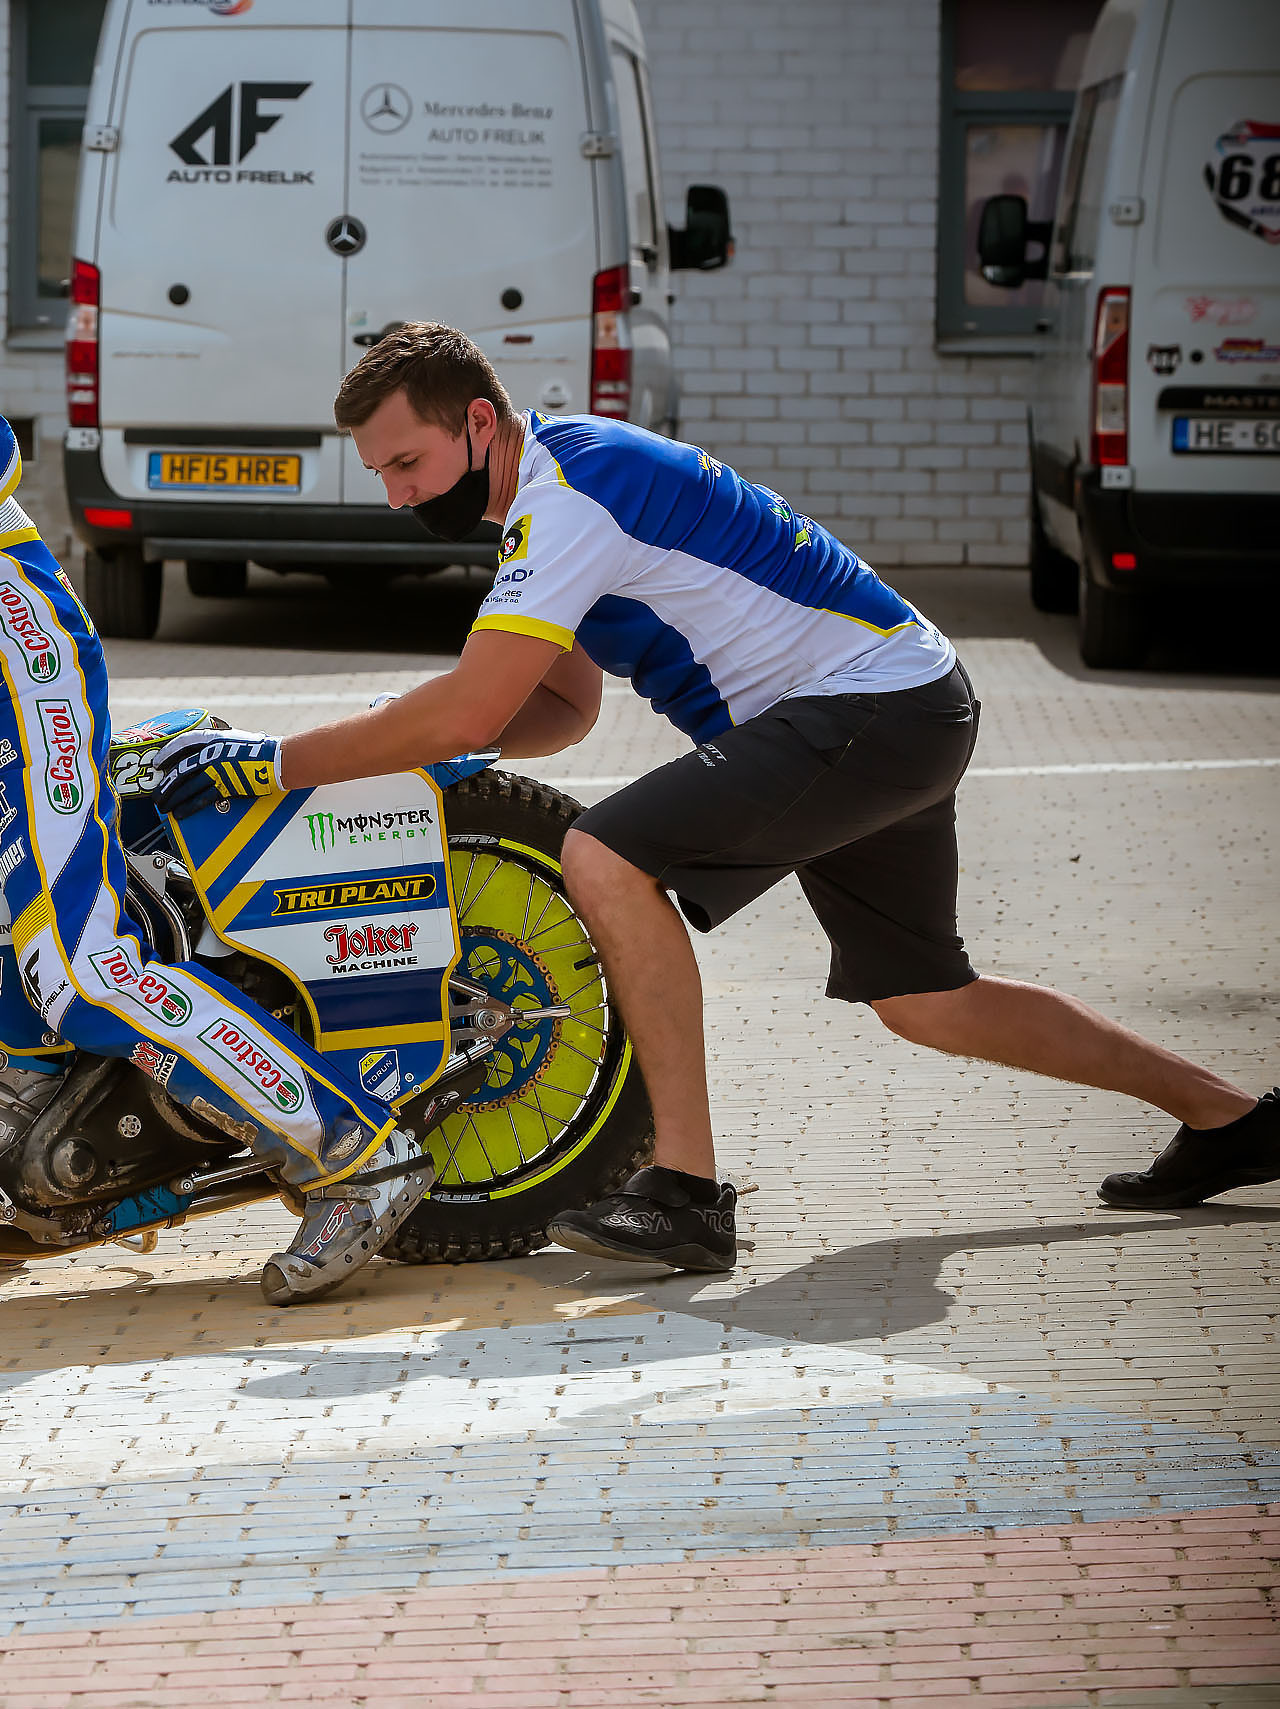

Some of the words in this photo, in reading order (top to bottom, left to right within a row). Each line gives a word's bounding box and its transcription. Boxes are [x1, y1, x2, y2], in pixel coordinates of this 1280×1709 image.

[428, 128, 479, 144] AUTO
[482, 129, 546, 145] FRELIK
[166, 170, 232, 184] AUTO
[236, 170, 314, 184] FRELIK
[170, 458, 229, 482] HF15
[237, 460, 289, 483] HRE
[45, 705, 76, 781] Castrol
[336, 809, 433, 833] MONSTER
[349, 828, 428, 844] ENERGY
[285, 890, 336, 910] TRU
[340, 880, 425, 903] PLANT
[323, 923, 419, 964] Joker
[332, 956, 418, 974] MACHINE
[210, 1022, 282, 1090] Castrol
